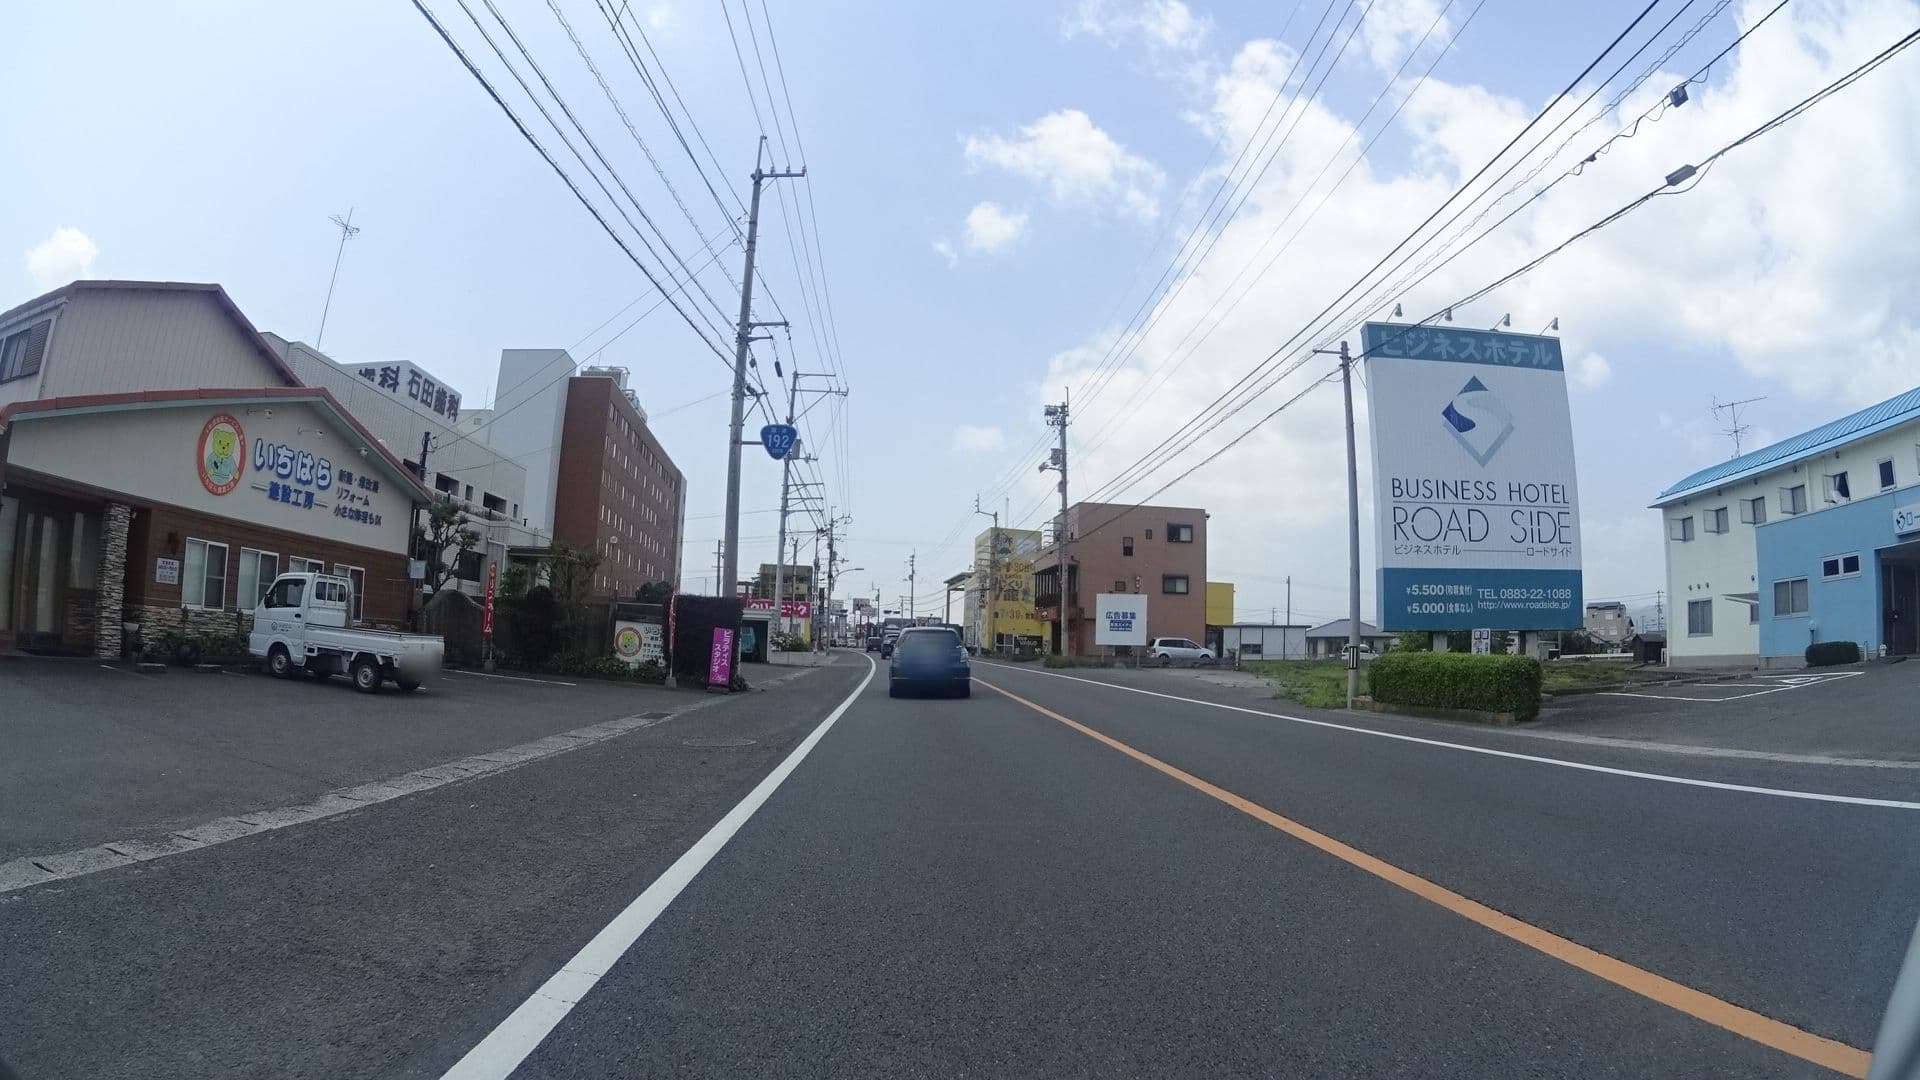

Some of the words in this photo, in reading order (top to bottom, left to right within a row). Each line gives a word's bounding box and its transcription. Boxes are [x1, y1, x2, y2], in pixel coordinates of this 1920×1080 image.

[1381, 329, 1552, 365] ビジネスホテル
[408, 368, 460, 423] 石田歯科
[768, 434, 789, 448] 192
[254, 437, 332, 490] いちはら
[268, 481, 315, 510] 建設工房
[337, 487, 370, 506] リフォーム
[1392, 478, 1497, 501] BUSINESS
[1508, 481, 1570, 504] HOTEL
[1393, 506, 1489, 543] ROAD
[1510, 509, 1572, 545] SIDE
[1394, 544, 1462, 556] ビジネスホテル
[1526, 546, 1572, 557] ロードサイド
[1477, 588, 1498, 599] TEL
[1500, 588, 1572, 600] 0883-22-1088
[1477, 600, 1572, 610] http://www.roadside.jp/
[712, 643, 722, 673] スタジオ
[720, 629, 732, 667] ピラティス
